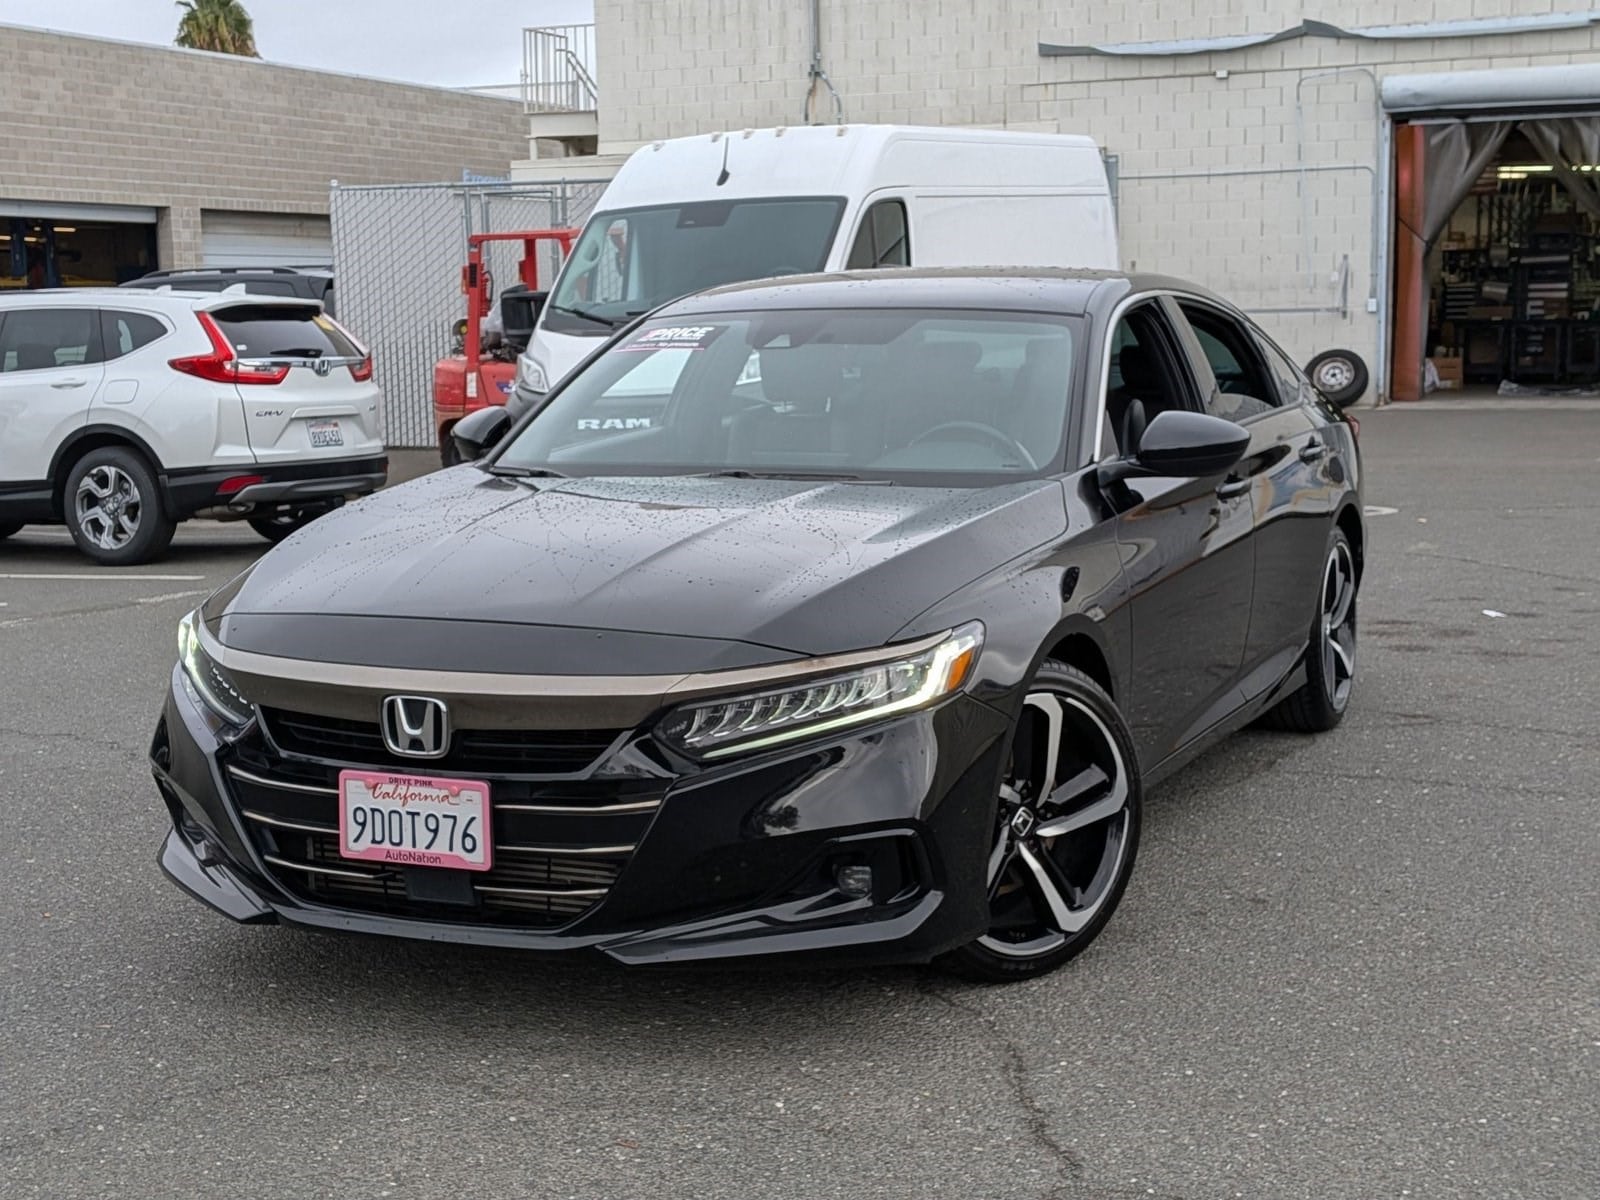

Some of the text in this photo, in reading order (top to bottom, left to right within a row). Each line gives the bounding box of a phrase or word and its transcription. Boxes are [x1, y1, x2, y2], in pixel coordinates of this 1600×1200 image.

[255, 409, 284, 417] CR-V
[577, 418, 651, 430] RAM
[388, 776, 434, 787] DRIVE PINK
[371, 782, 460, 807] California
[352, 806, 478, 854] 9DOT976
[384, 850, 442, 865] AutoNation
